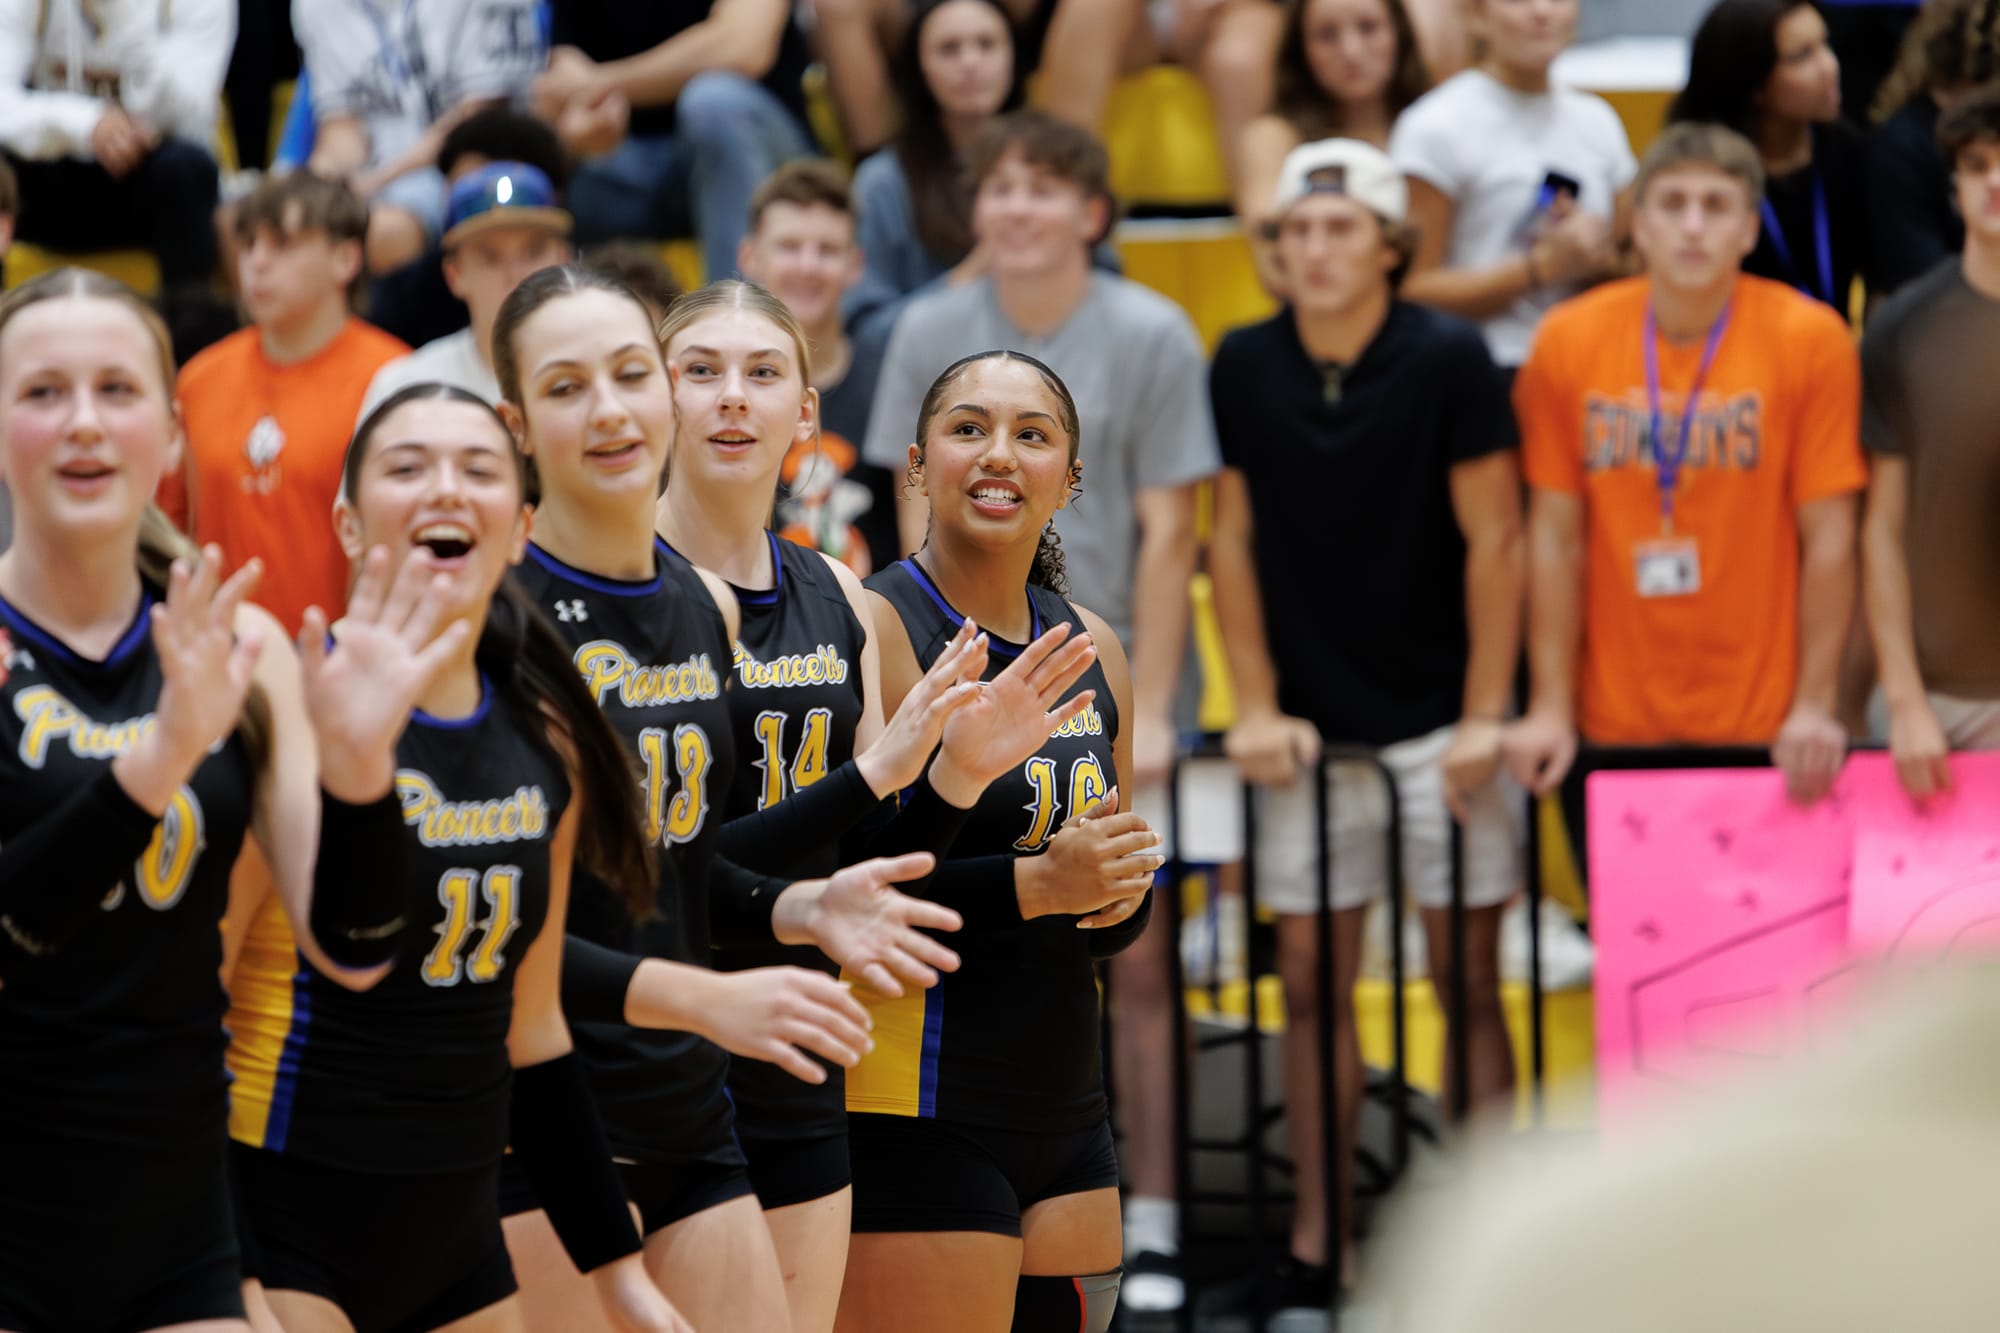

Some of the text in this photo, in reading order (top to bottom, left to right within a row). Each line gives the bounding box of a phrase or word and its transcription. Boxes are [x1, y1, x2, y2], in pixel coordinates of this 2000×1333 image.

[1583, 390, 1764, 471] COWOYS
[573, 640, 720, 708] Pioneers
[638, 722, 714, 849] 13
[751, 707, 832, 812] 14
[1013, 750, 1108, 851] 16
[101, 783, 205, 911] 0
[420, 865, 523, 987] 11
